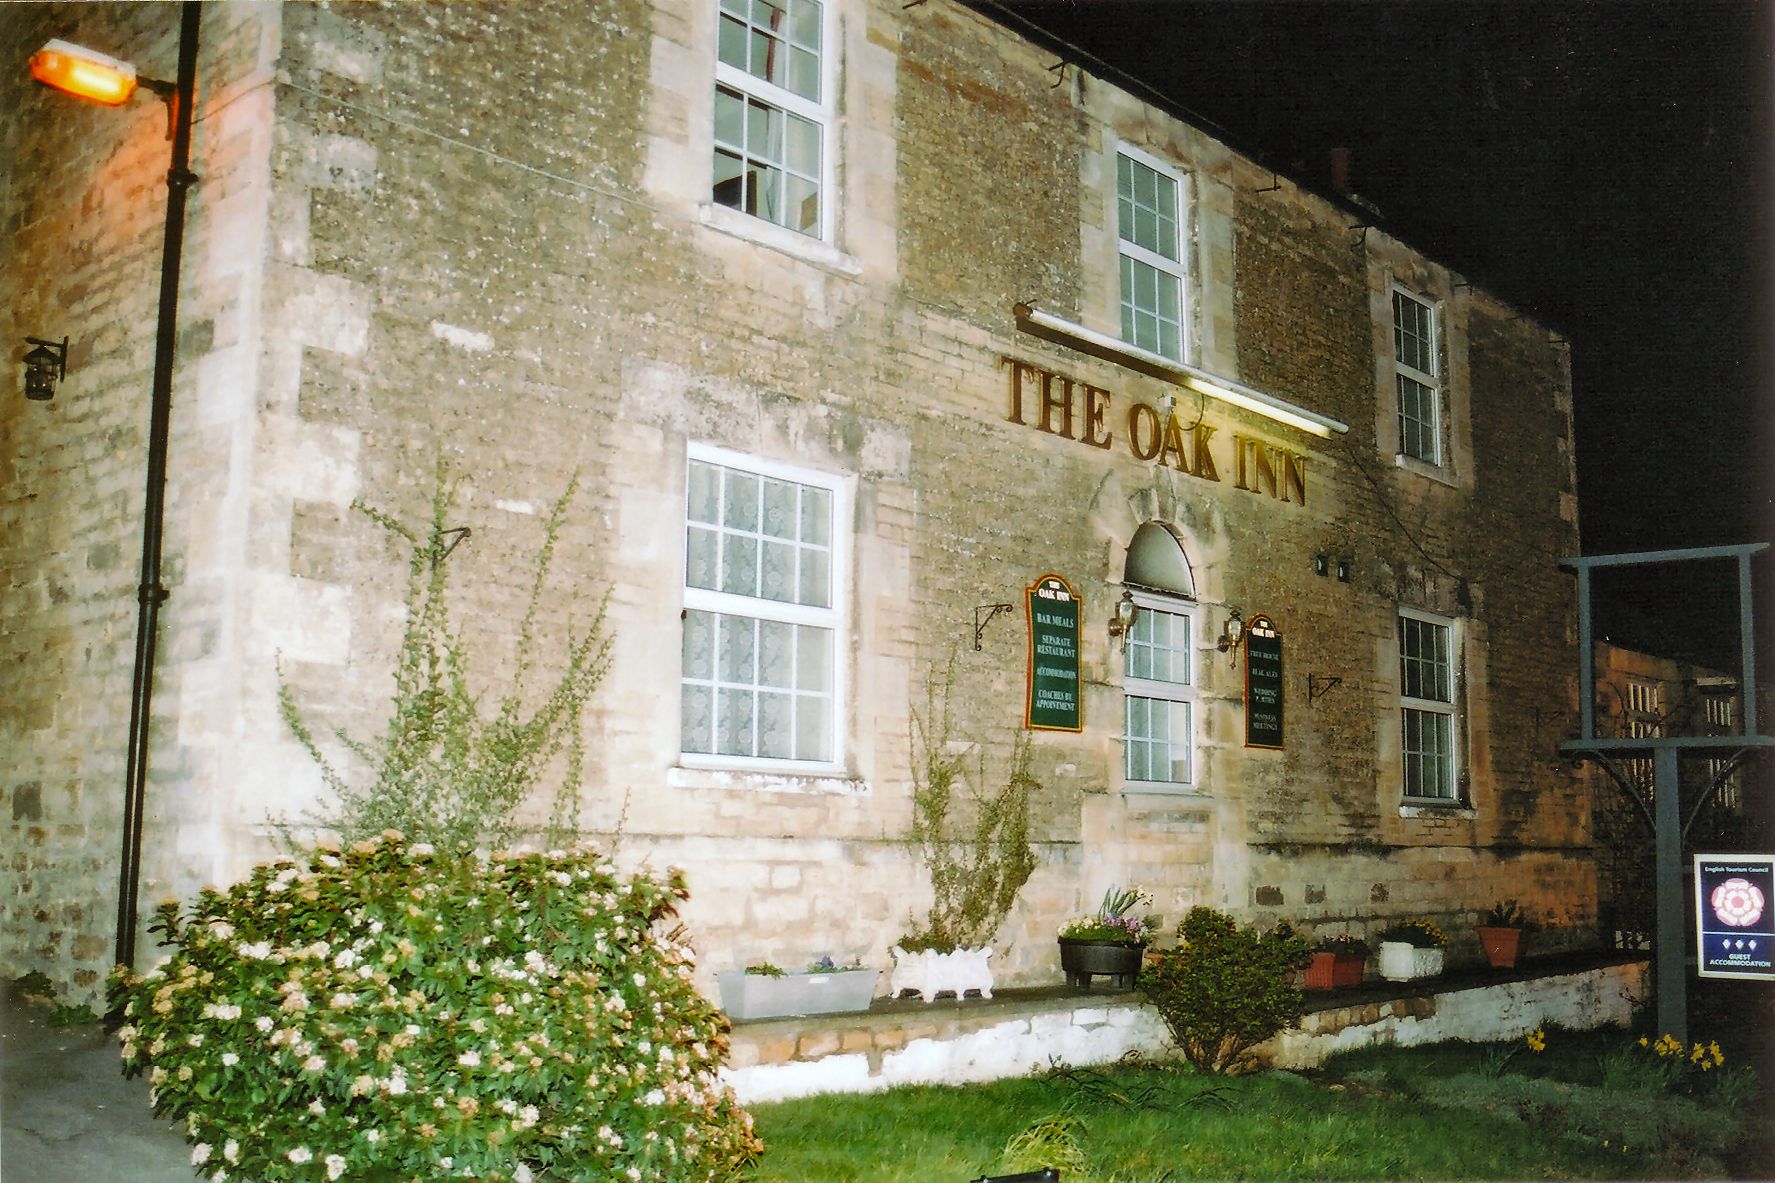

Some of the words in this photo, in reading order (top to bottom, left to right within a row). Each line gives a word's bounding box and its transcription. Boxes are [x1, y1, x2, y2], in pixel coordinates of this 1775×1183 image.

[1000, 355, 1112, 450] THE
[1128, 403, 1220, 482] OAK
[1233, 434, 1306, 507] INN
[1038, 588, 1055, 600] OAK
[1056, 591, 1070, 601] INN
[1037, 613, 1051, 624] BAR
[1052, 615, 1074, 629] MEALS
[1252, 627, 1265, 637] OAK
[1042, 635, 1071, 647] SEPARATE
[1037, 645, 1076, 658] RESTAURANT
[1038, 689, 1064, 700] COACHES
[1065, 691, 1072, 701] BY
[1036, 700, 1075, 711] APPOINTMENT
[1709, 959, 1771, 968] ACCOMMODATION
